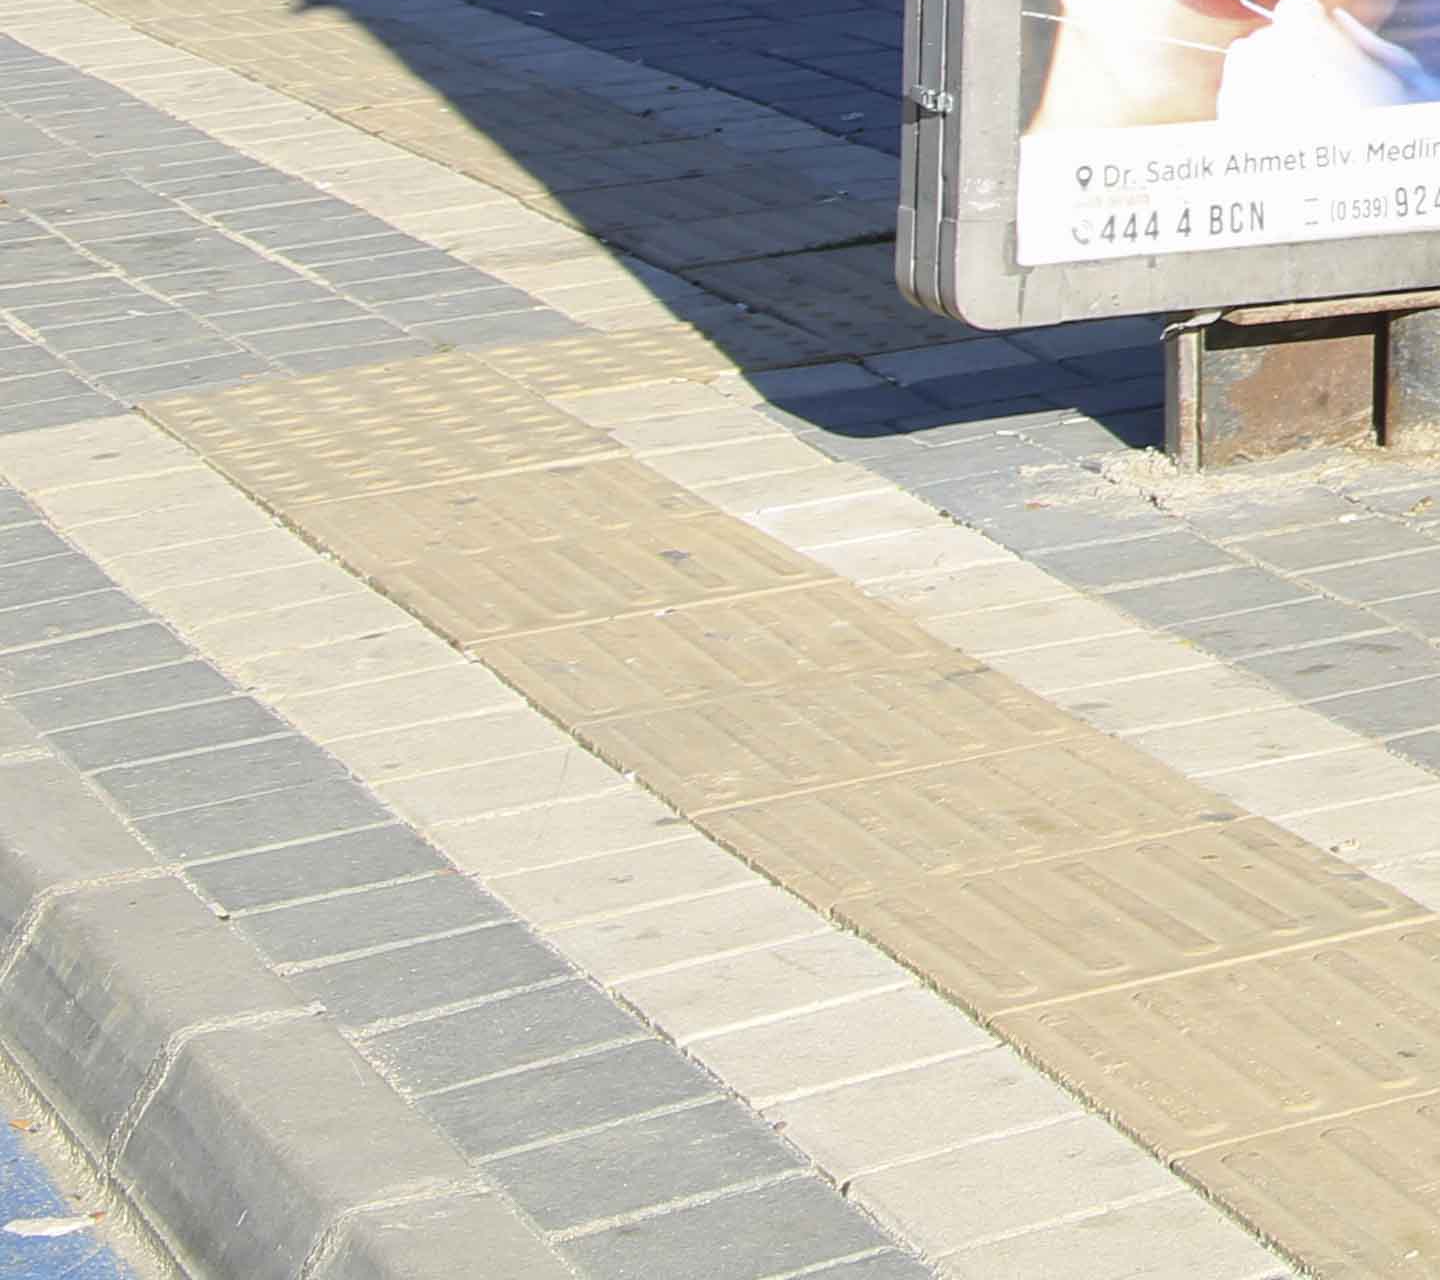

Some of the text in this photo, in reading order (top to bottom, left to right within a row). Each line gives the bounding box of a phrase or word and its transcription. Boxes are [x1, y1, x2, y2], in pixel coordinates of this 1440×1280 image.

[1103, 164, 1137, 188] Dr.
[1147, 158, 1214, 184] Sadık
[1225, 150, 1306, 177] Ahmet
[1315, 146, 1356, 168] Blv.
[1100, 200, 1265, 243] 444 4 BCN
